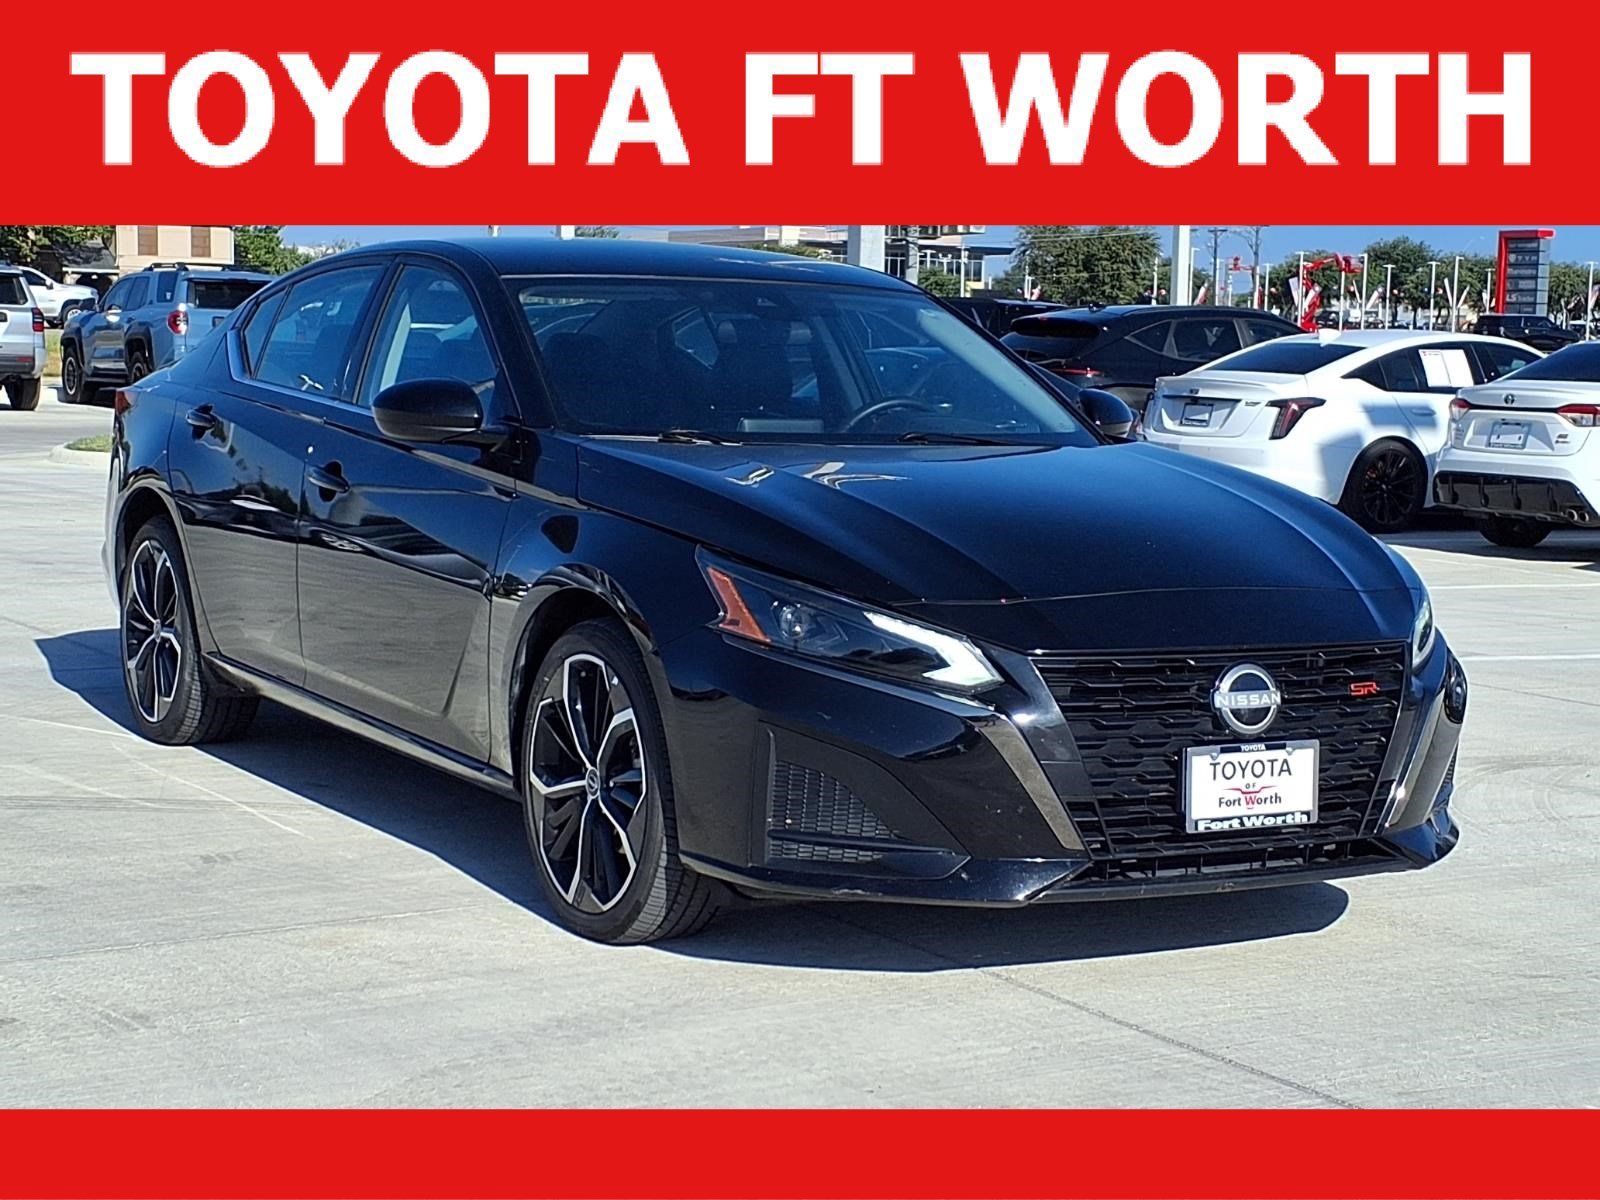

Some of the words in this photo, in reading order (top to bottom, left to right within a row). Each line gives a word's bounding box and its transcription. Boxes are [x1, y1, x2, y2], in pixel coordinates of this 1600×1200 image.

[1350, 681, 1380, 696] SR
[1216, 693, 1281, 706] NISSAN
[1240, 743, 1267, 752] TOYOTA
[1209, 758, 1292, 782] TOYOTA
[1218, 796, 1242, 808] Fort
[1244, 792, 1282, 807] Worth
[1197, 816, 1243, 832] Fort
[1242, 811, 1309, 828] Worth
